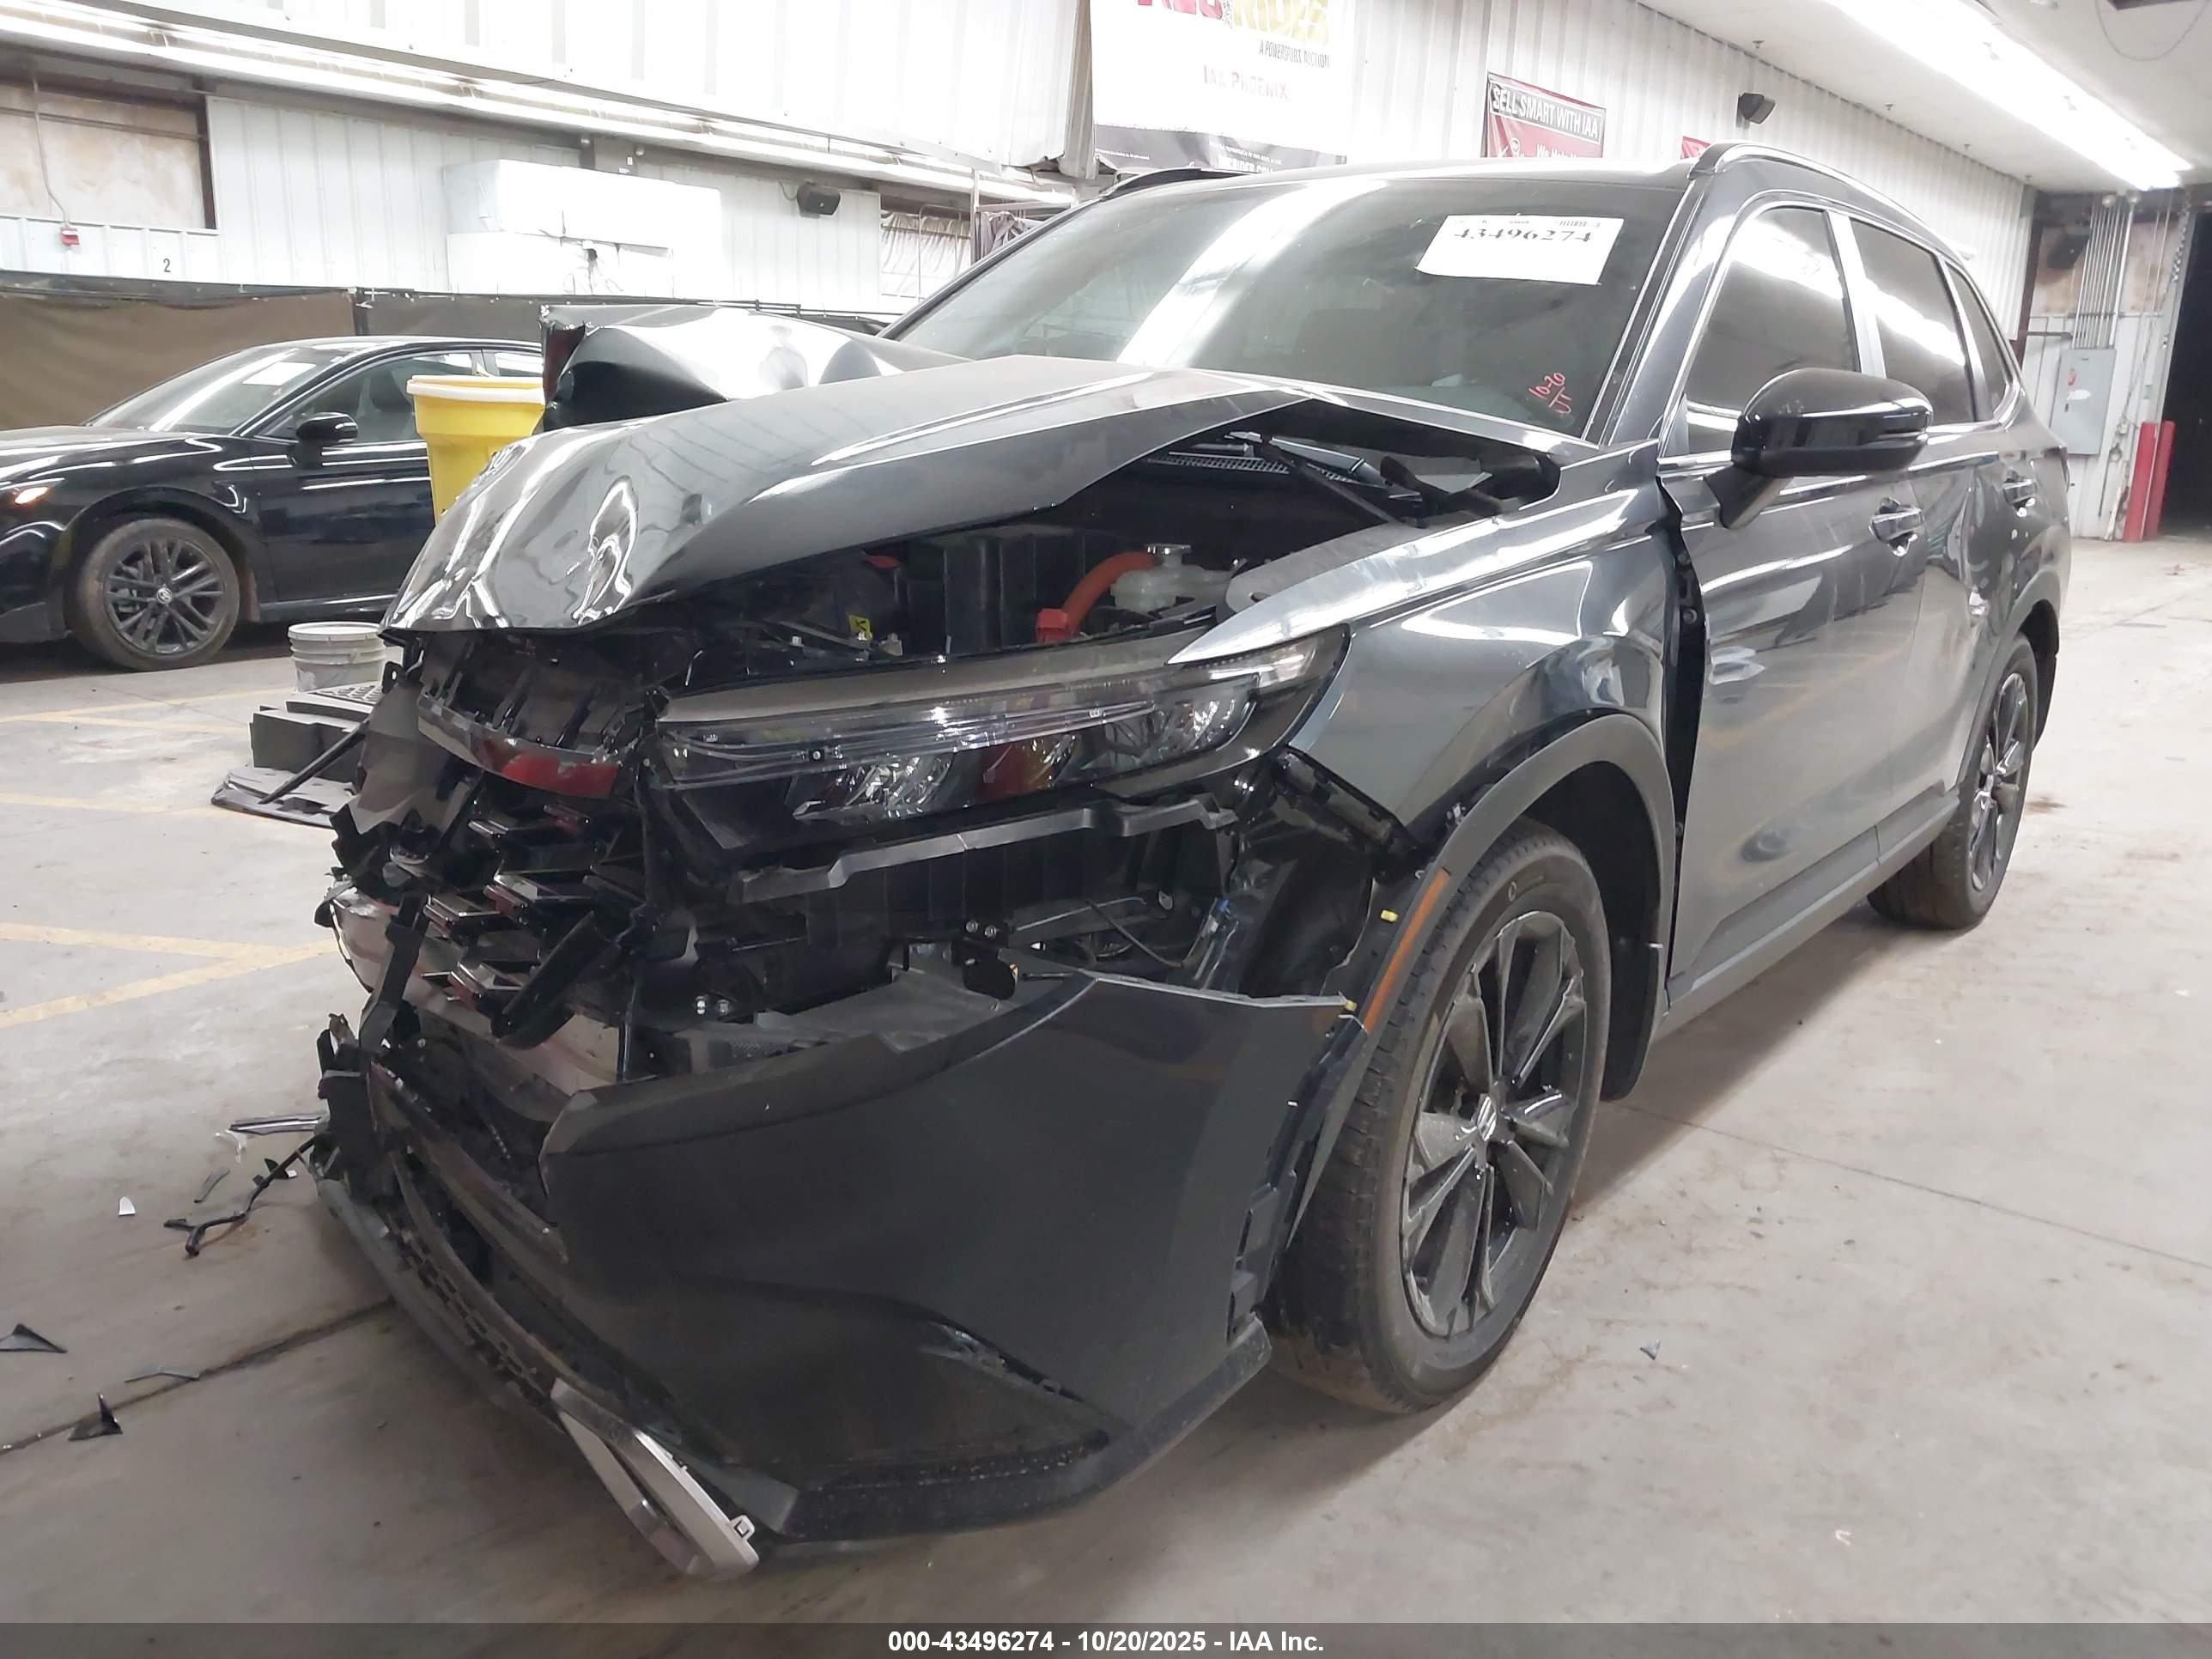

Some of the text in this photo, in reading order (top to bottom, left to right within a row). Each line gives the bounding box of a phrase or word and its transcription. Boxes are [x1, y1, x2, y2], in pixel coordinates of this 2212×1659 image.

[1264, 40, 1302, 64] POWERSPORT
[1304, 50, 1330, 69] AUCTION
[1492, 84, 1598, 137] SELL SMART WITH IAA
[162, 258, 171, 272] 2
